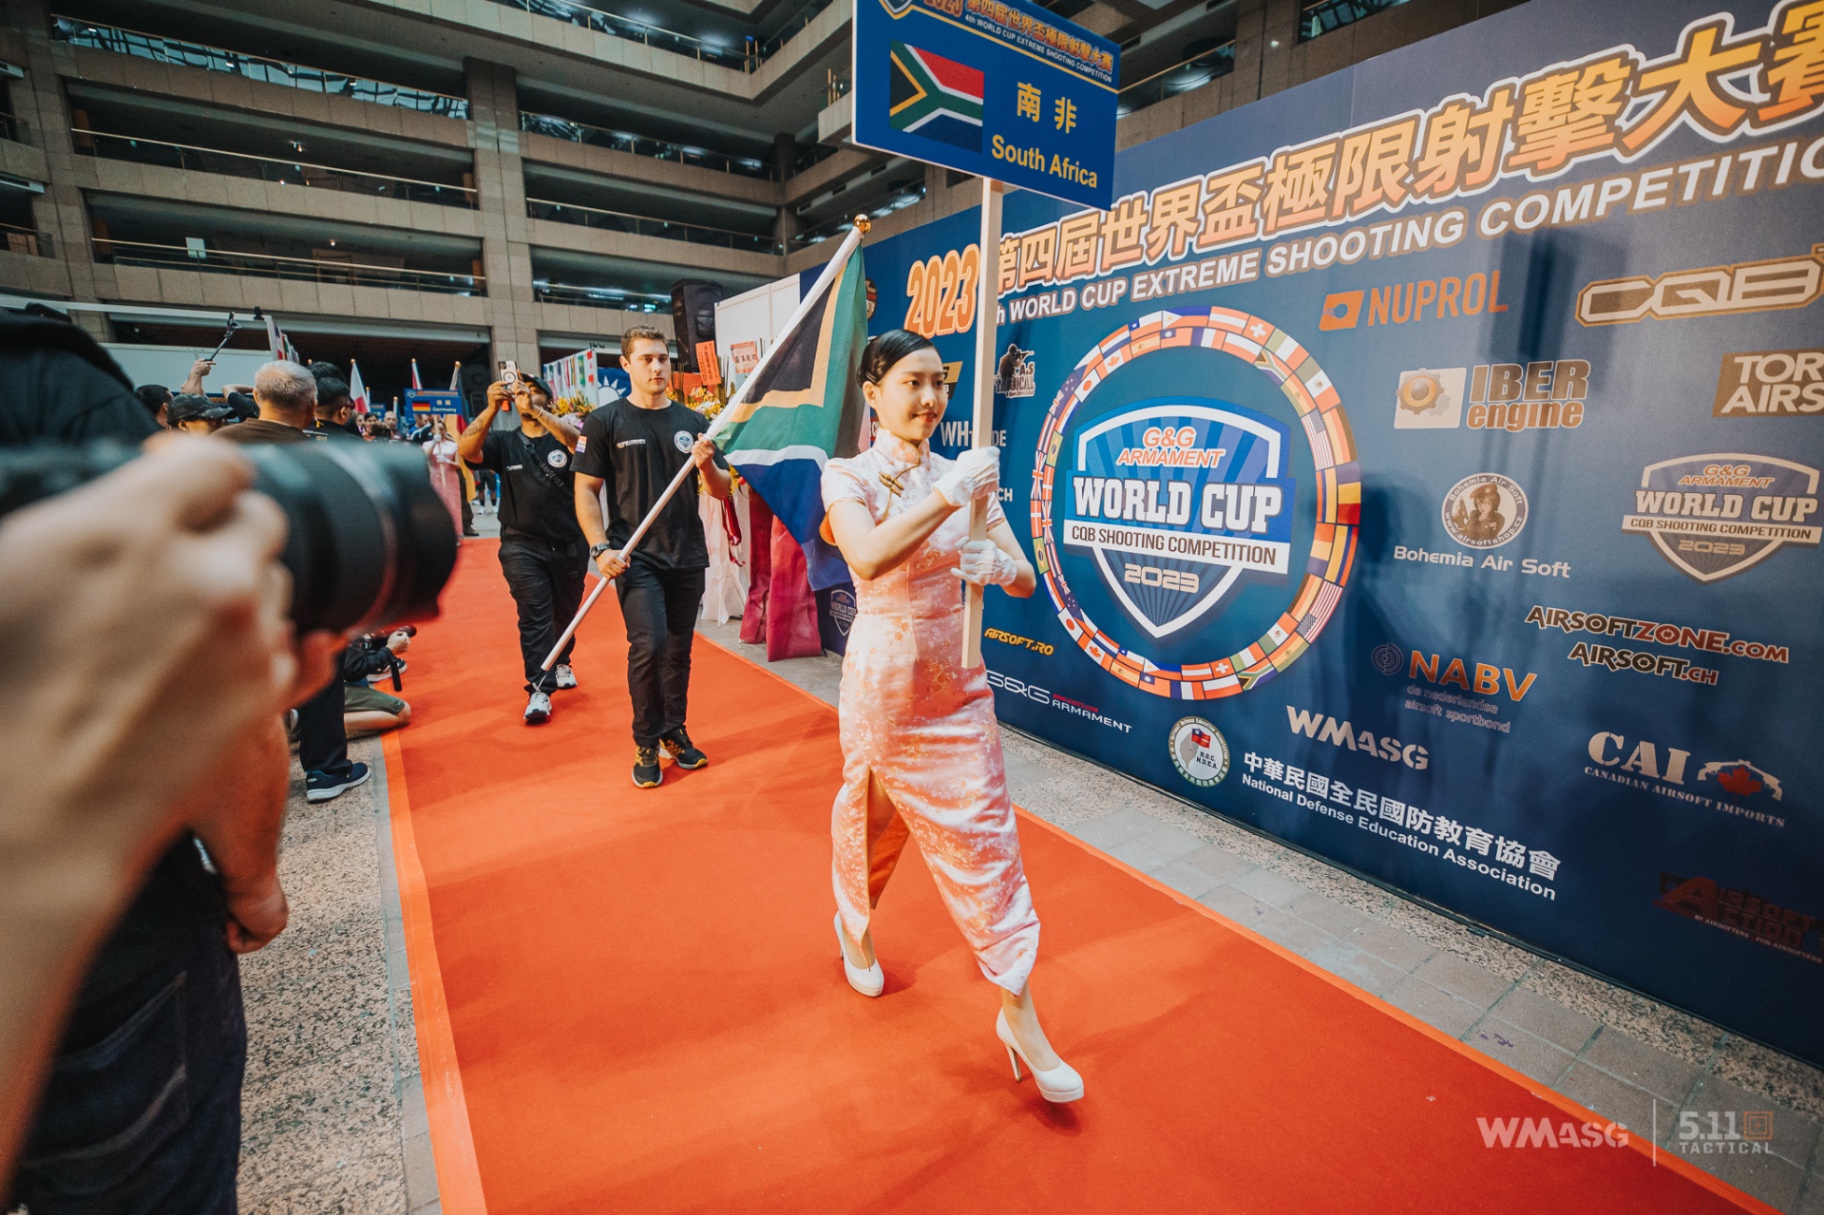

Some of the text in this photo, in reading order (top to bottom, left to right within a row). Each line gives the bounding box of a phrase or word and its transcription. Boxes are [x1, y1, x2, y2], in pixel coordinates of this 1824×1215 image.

[964, 14, 1112, 83] 4th WORLD CUP EXTREME SHOOTING COMPETITION
[991, 134, 1098, 189] South Africa
[1010, 291, 1076, 322] WORLD
[1081, 279, 1127, 308] CUP
[1133, 251, 1259, 299] EXTREME
[1267, 210, 1466, 276] SHOOTING
[905, 244, 980, 339] 2023
[1367, 270, 1509, 326] NUPROL
[1577, 257, 1822, 325] CQB
[1469, 359, 1591, 403] IBER
[1734, 352, 1824, 384] TOR
[1467, 401, 1585, 432] engine
[1142, 426, 1196, 448] G&G
[1116, 448, 1226, 468] ARMAMENT
[1703, 464, 1751, 477] G&G
[1449, 476, 1524, 505] Bohemia Air Soft
[1678, 475, 1775, 488] ARMAMENT
[1072, 476, 1283, 535] WORLD CUP
[1635, 490, 1819, 522] WORLD CUP
[1072, 525, 1276, 566] CQB SHOOTING COMPETITION
[1445, 511, 1523, 546] www.airsoftshop.cz
[1630, 518, 1812, 540] CQB SHOOTING COMPETITION
[1678, 539, 1746, 555] 2023
[1124, 563, 1200, 593] 2023
[1393, 546, 1572, 579] Bohemia Air Soft
[984, 628, 1055, 656] AIRSOFT.RO
[1525, 605, 1789, 664] AIRSOFTZONE.COM
[1409, 650, 1538, 702] NABV
[1567, 641, 1719, 686] AIRSOFT.CH
[986, 669, 1050, 704] G&G
[1407, 684, 1499, 714] de nederlandse
[1052, 699, 1133, 734] ARMAMENT
[1404, 699, 1511, 734] airsoft sportbond
[1286, 705, 1429, 771] WMASG
[1588, 731, 1691, 785] CAI
[1584, 766, 1785, 828] CANADIAN AIRSOFT IMPORTS
[1243, 751, 1562, 882] 中華民國全民國防教育協會
[1242, 774, 1556, 901] National Defense Education Association
[1705, 918, 1750, 939] AIRSOFTERS
[1756, 936, 1771, 946] FOR
[1772, 942, 1823, 965] AIRSOFTERS
